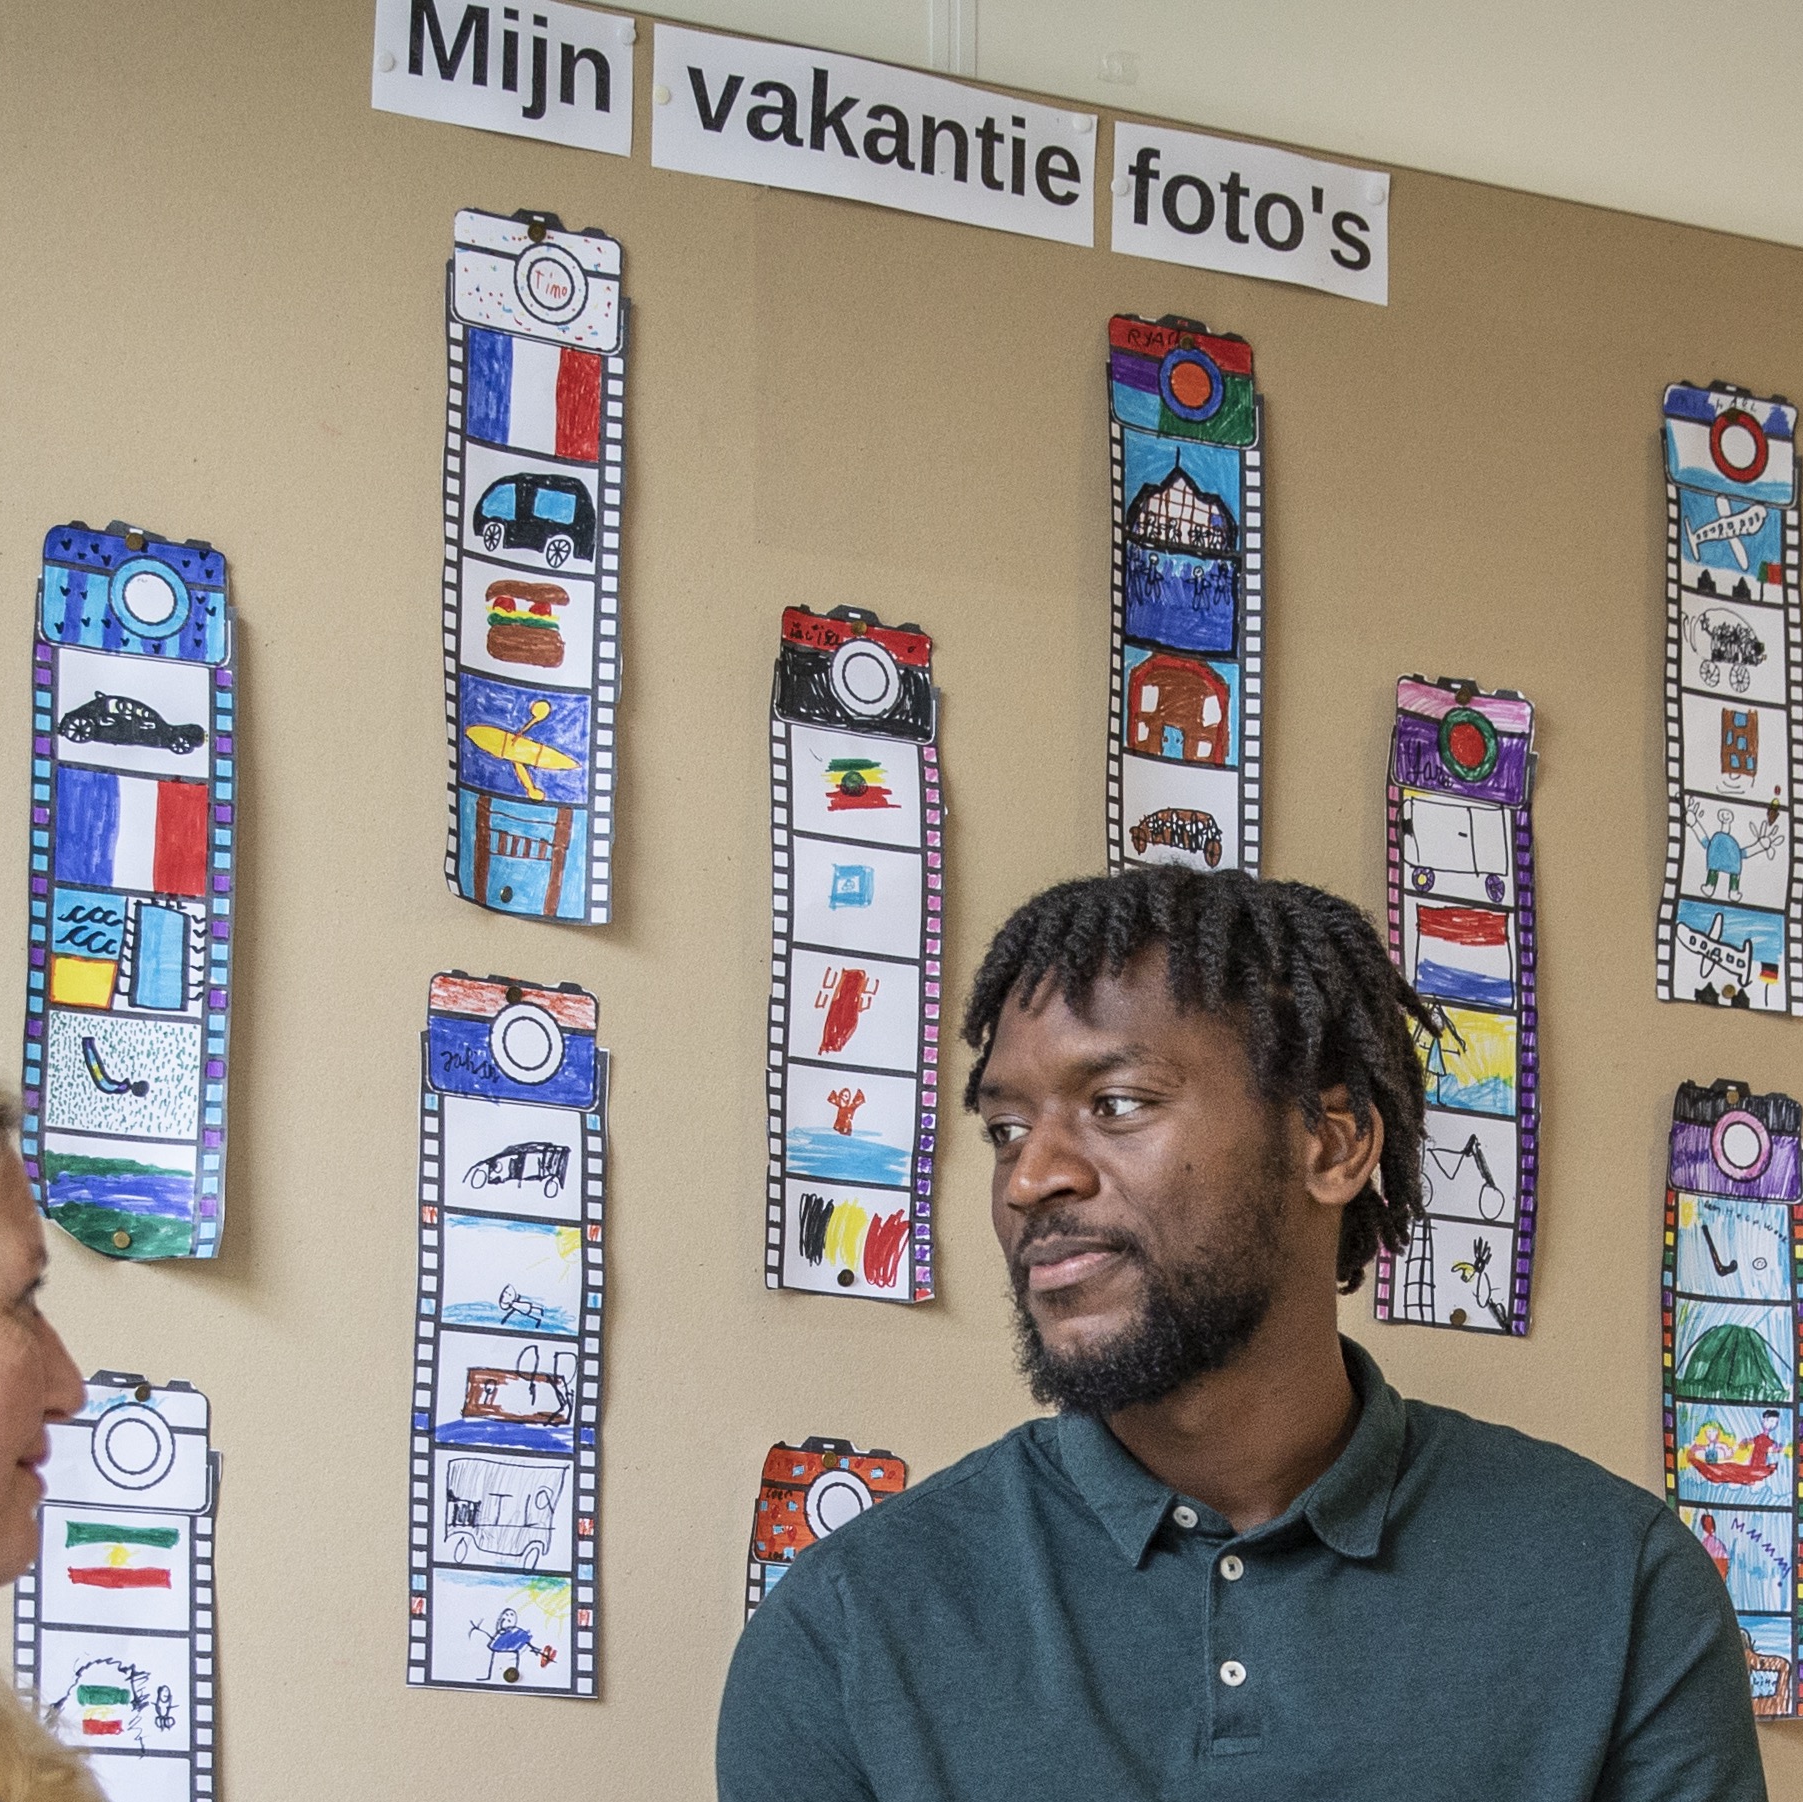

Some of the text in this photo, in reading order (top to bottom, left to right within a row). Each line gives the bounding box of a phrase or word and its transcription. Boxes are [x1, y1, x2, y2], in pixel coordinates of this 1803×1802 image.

[408, 0, 1372, 271] Mijn vakantie foto's
